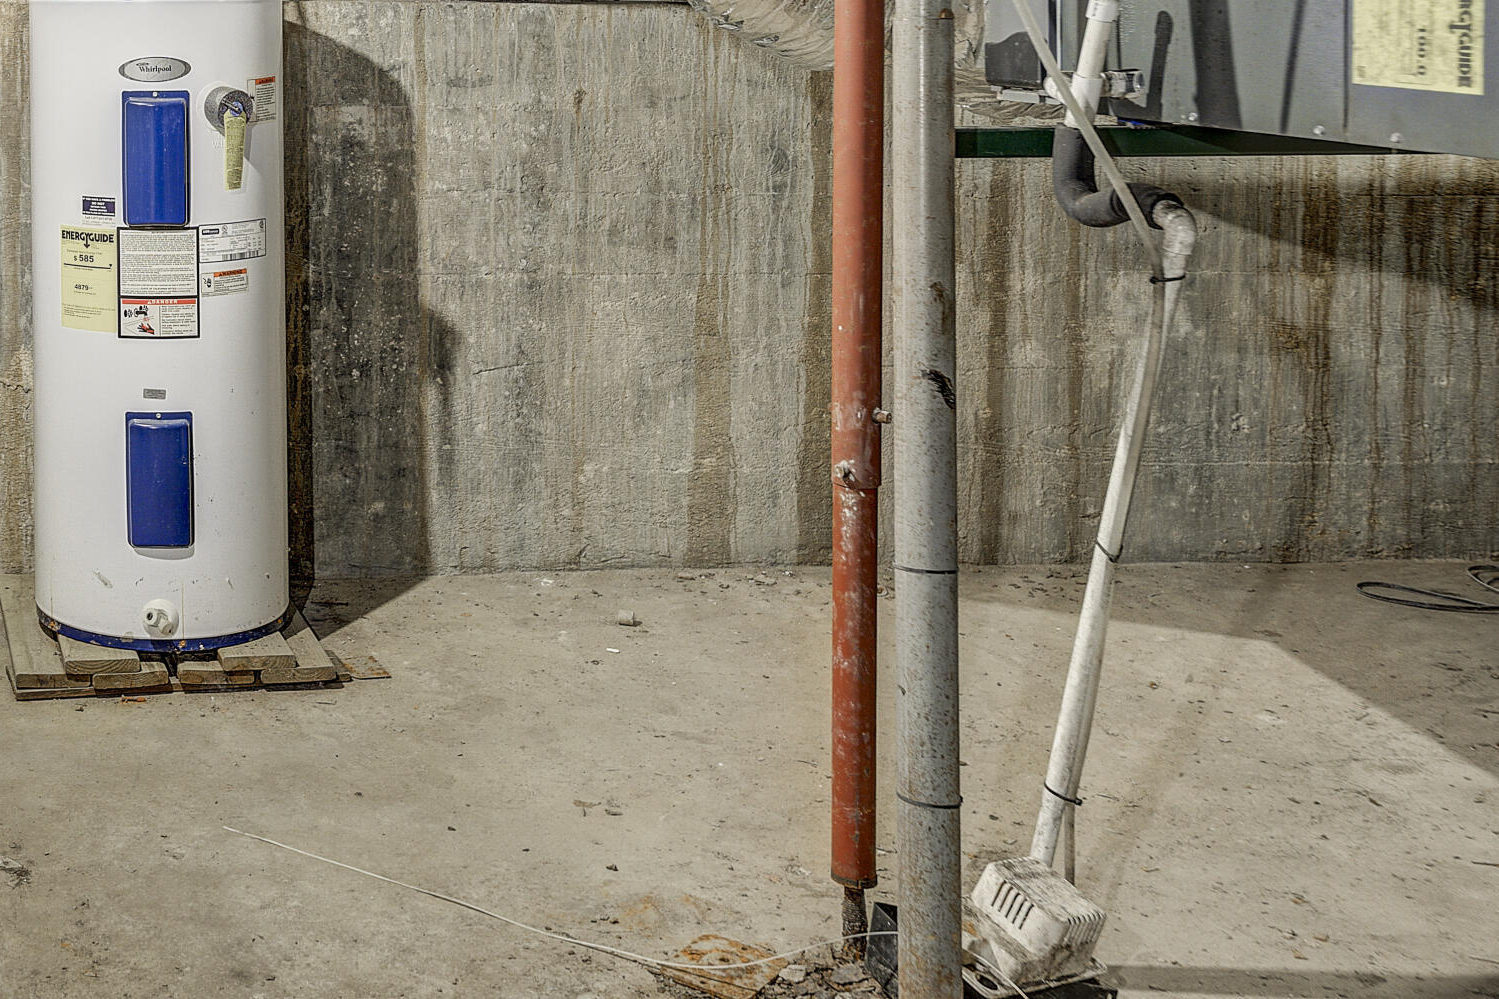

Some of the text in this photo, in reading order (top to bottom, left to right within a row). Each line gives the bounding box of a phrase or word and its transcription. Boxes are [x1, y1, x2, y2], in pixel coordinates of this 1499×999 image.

[139, 65, 172, 74] Whirlpool
[62, 230, 114, 248] ENERGYGUIDE
[79, 254, 94, 263] 585
